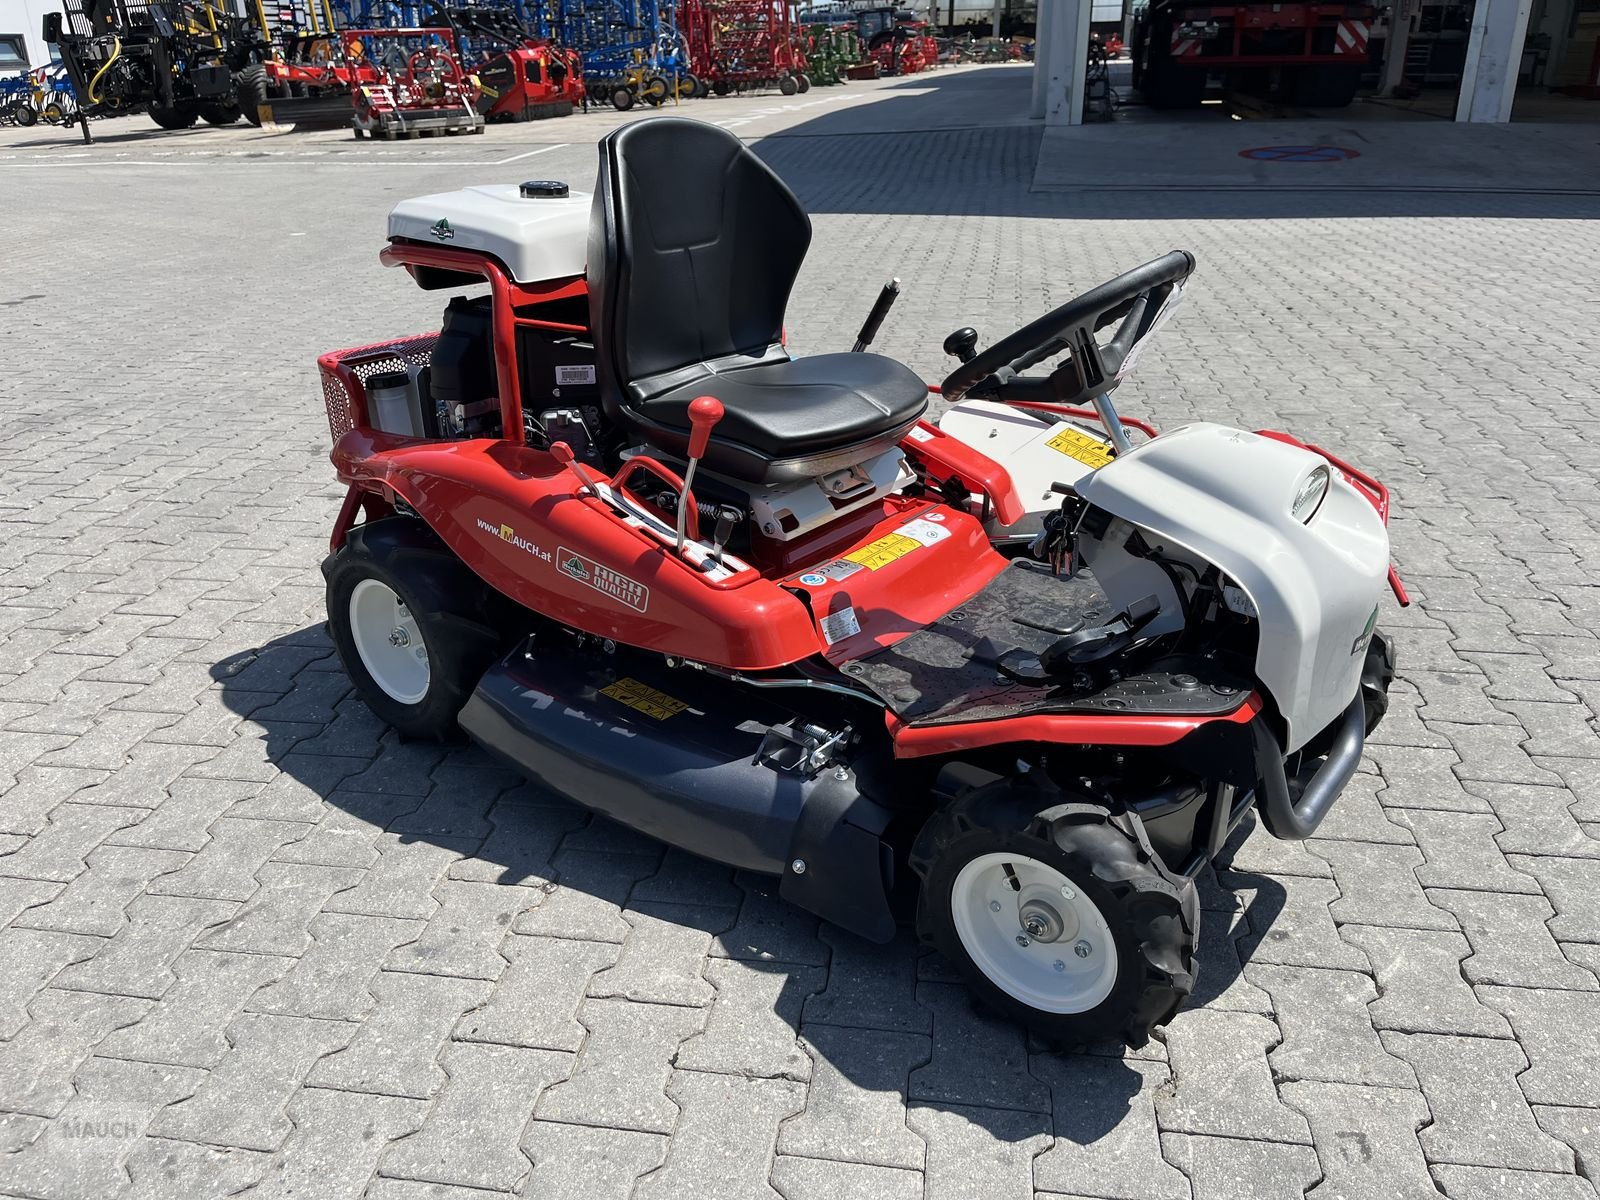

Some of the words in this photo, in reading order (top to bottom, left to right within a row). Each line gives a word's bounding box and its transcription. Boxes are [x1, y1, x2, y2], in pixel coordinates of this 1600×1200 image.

[477, 518, 552, 563] www.MAUCH.at
[593, 577, 641, 606] QUALITY
[594, 565, 643, 597] HIGH
